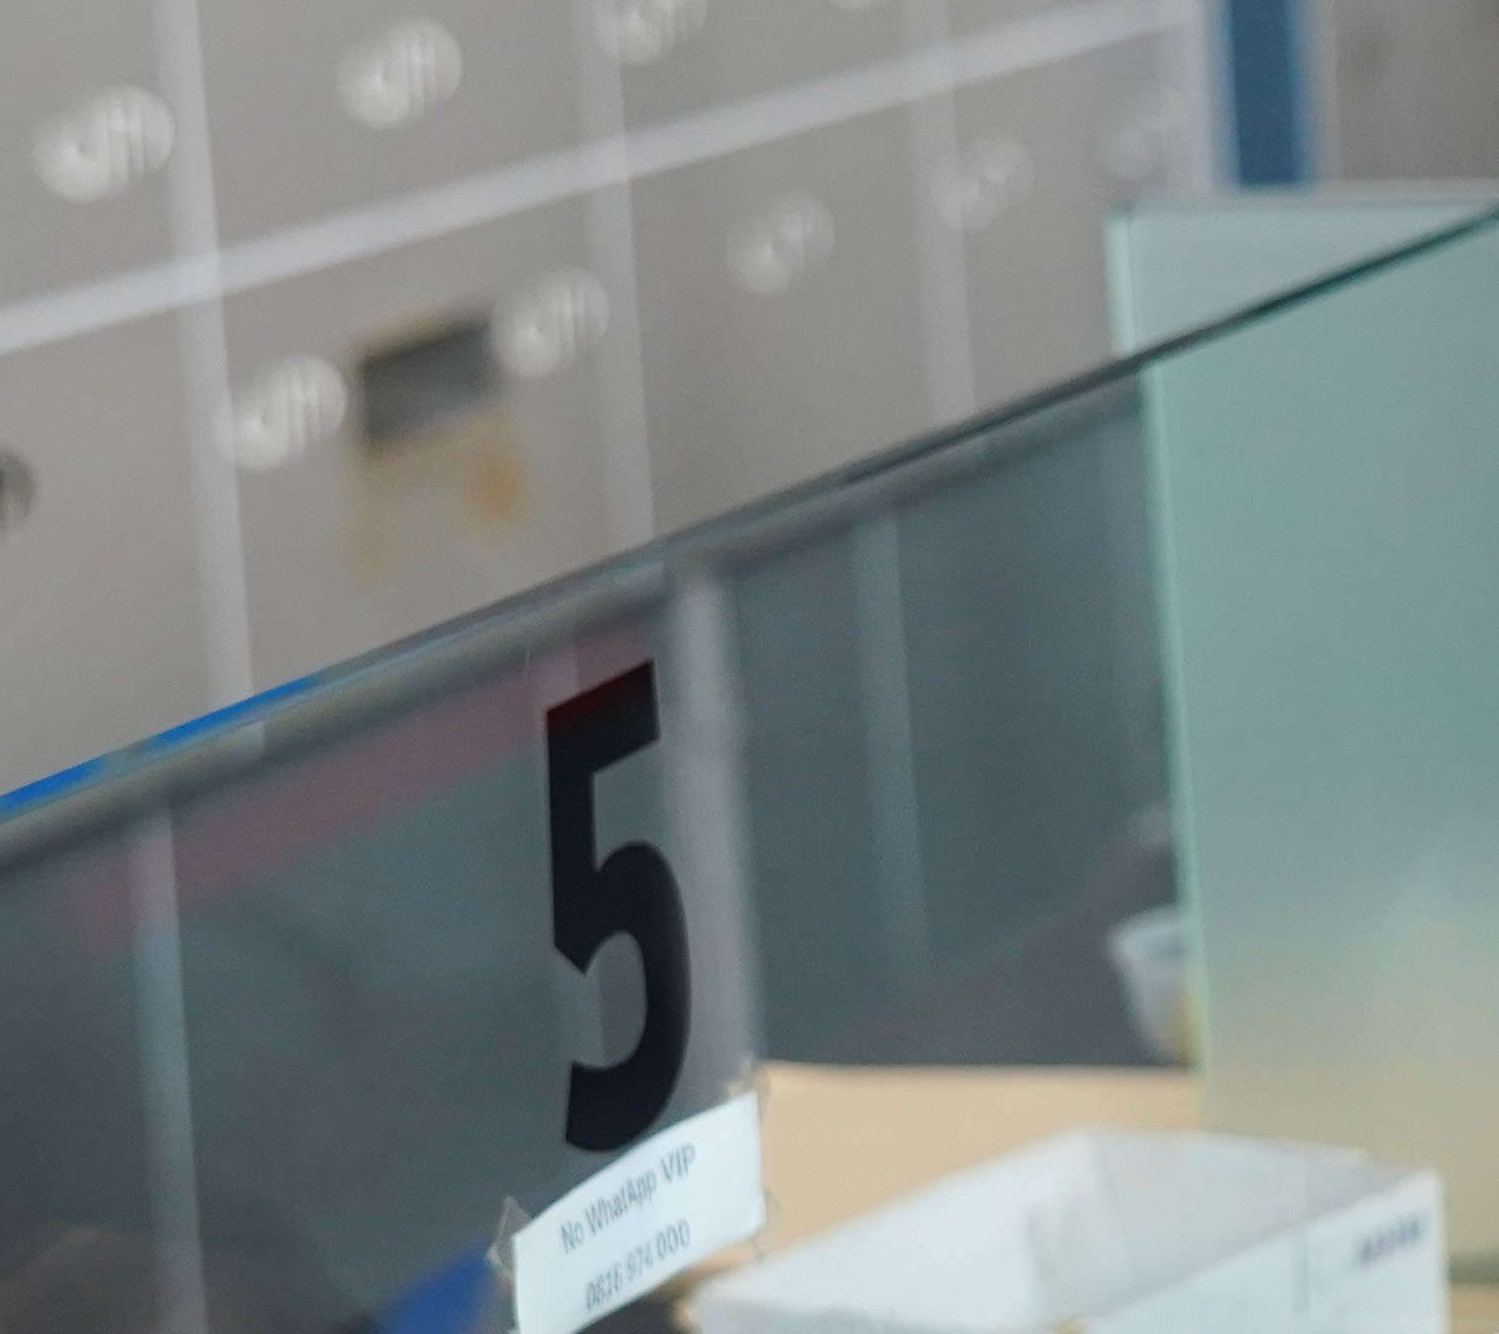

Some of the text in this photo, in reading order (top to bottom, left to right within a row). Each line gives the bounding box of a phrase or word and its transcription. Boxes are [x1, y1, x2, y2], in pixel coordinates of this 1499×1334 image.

[545, 660, 691, 1153] 5
[560, 1222, 585, 1254] No
[660, 1142, 697, 1183] VIP
